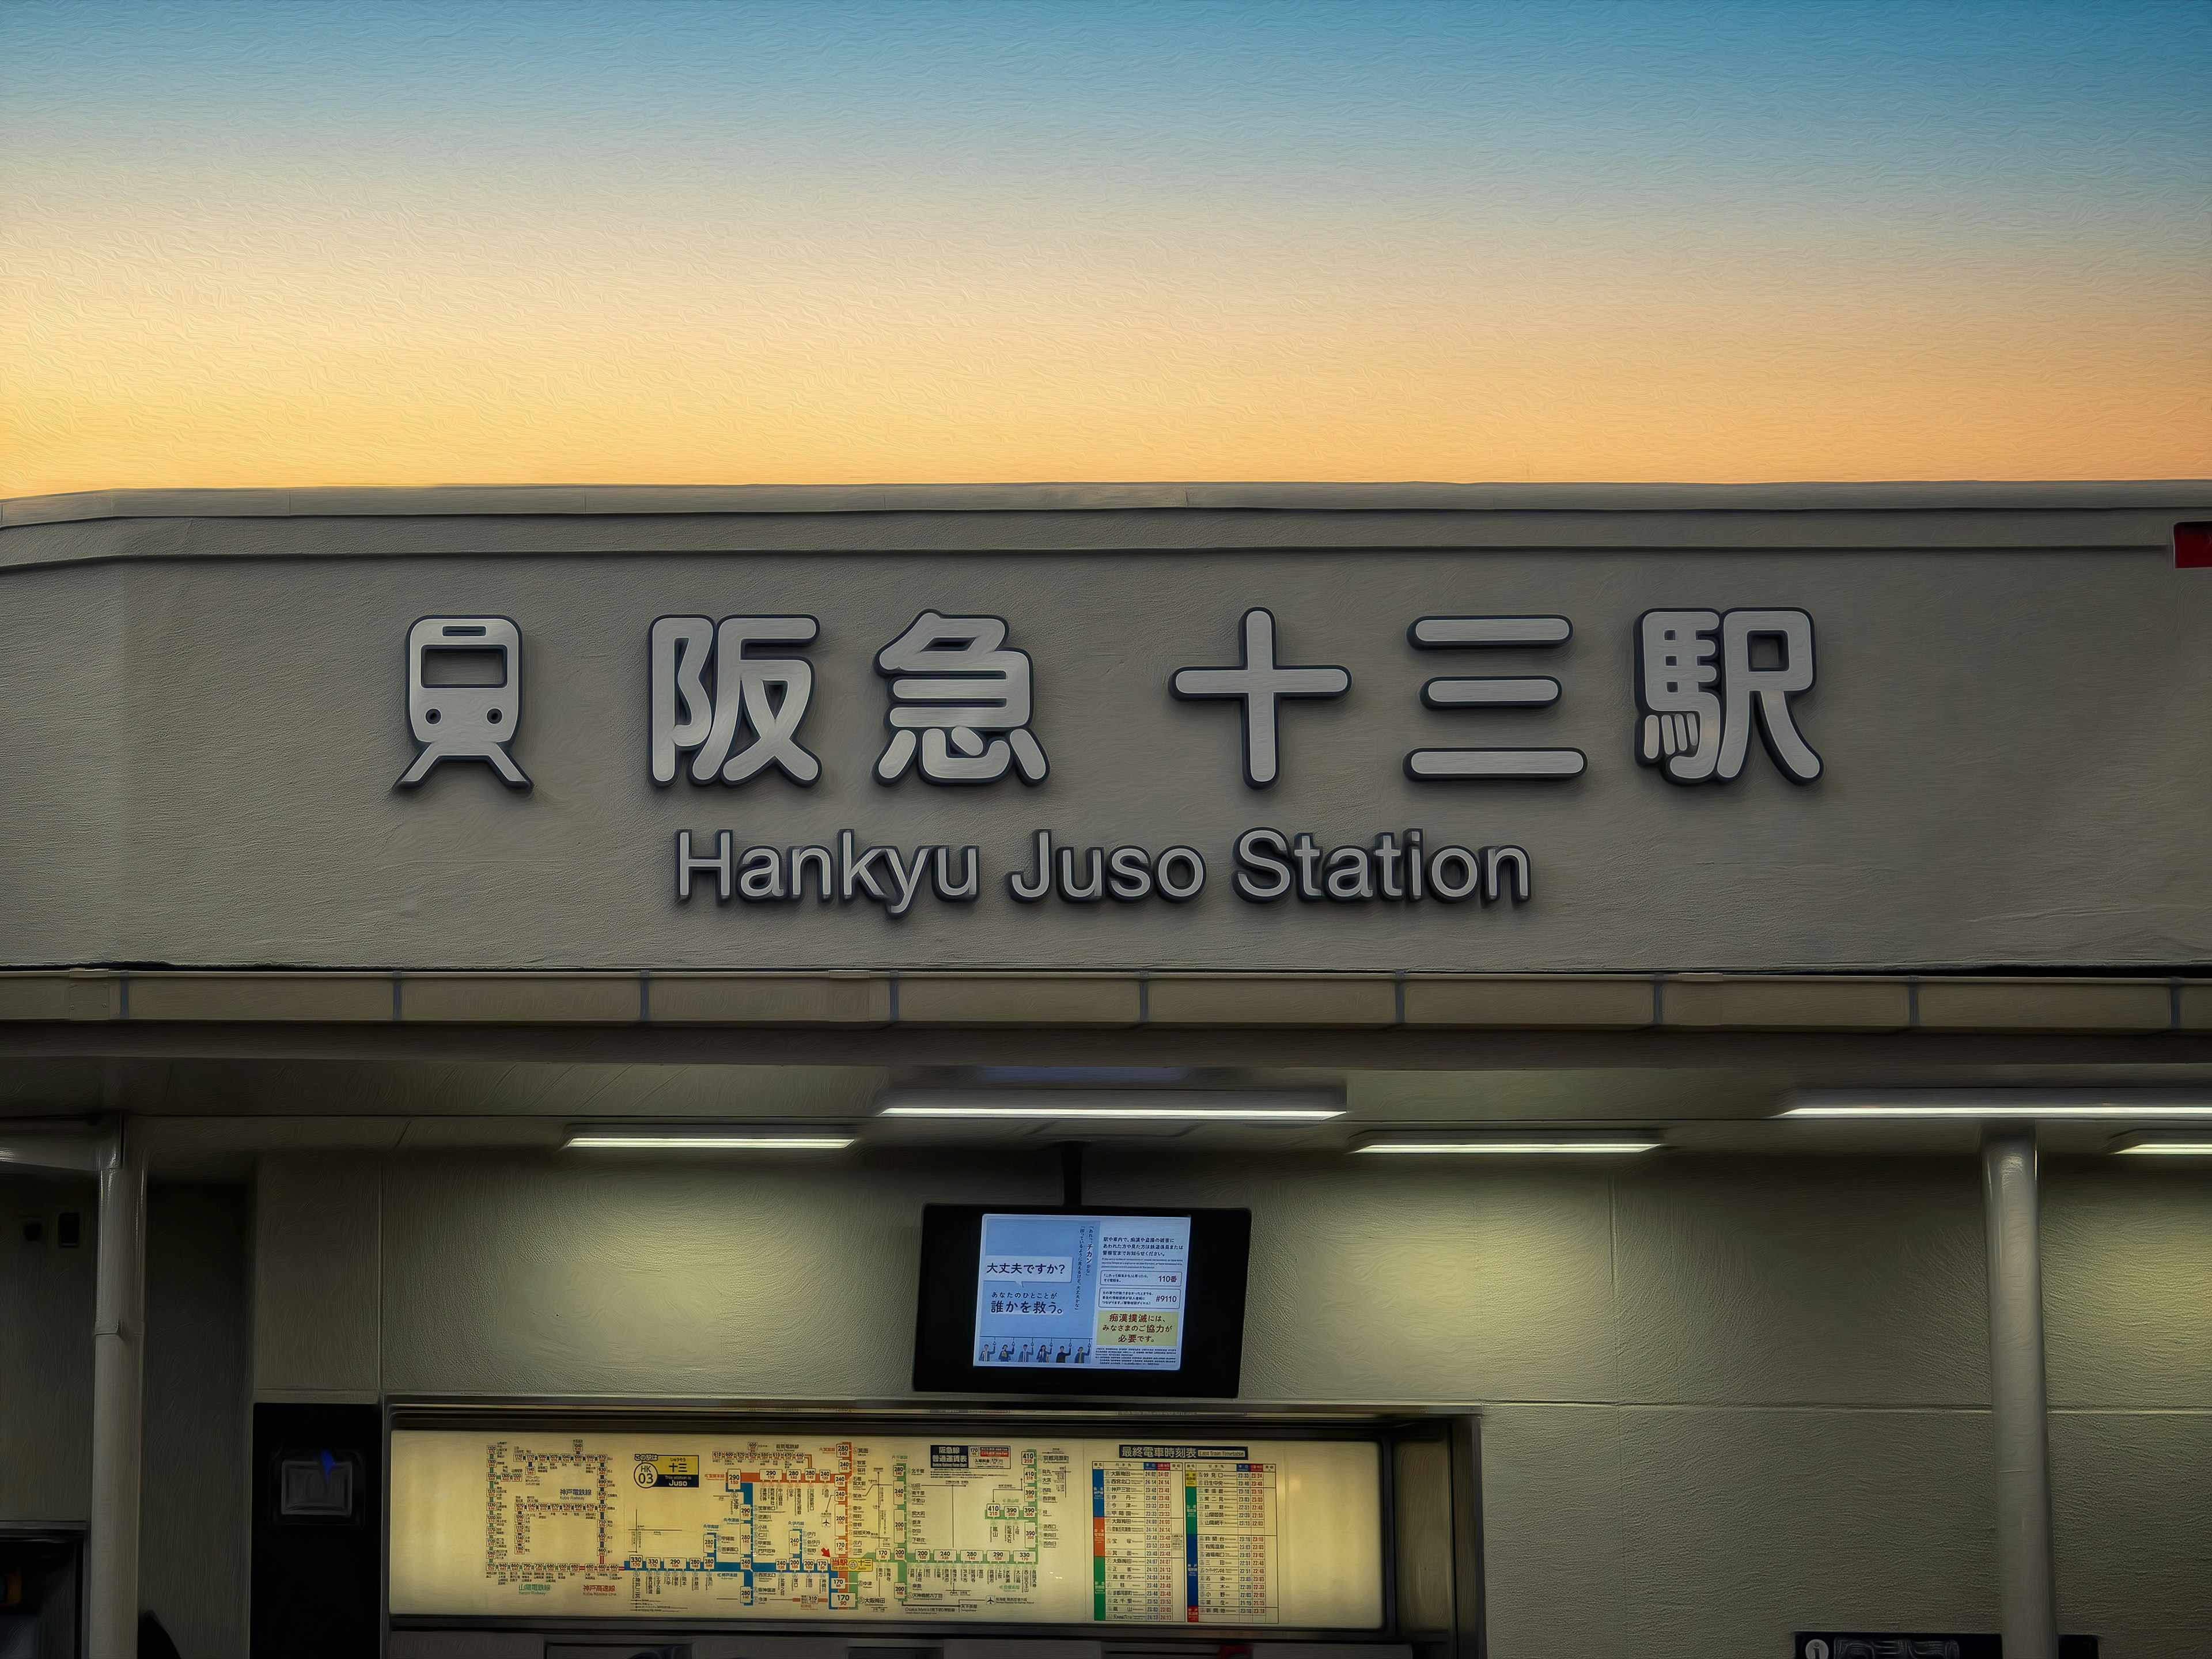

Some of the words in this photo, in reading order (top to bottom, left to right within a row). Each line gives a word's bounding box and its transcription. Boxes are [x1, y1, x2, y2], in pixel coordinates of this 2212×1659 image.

[649, 609, 1050, 788] 阪急
[1168, 606, 1824, 790] 十三駅
[675, 828, 980, 919] Hankyu
[1006, 828, 1207, 903] Juso
[1232, 827, 1532, 906] Station
[987, 1263, 1065, 1274] 大丈夫ですか?
[991, 1301, 1063, 1314] 誰かを救う。
[1109, 1314, 1166, 1323] 痴漢撲滅には、
[1103, 1325, 1172, 1333] みなさまのご協力が
[1118, 1335, 1154, 1343] 必要です。
[1122, 1446, 1196, 1458] 最終電車時刻表
[669, 1463, 687, 1472] 十三
[638, 1474, 653, 1484] 03
